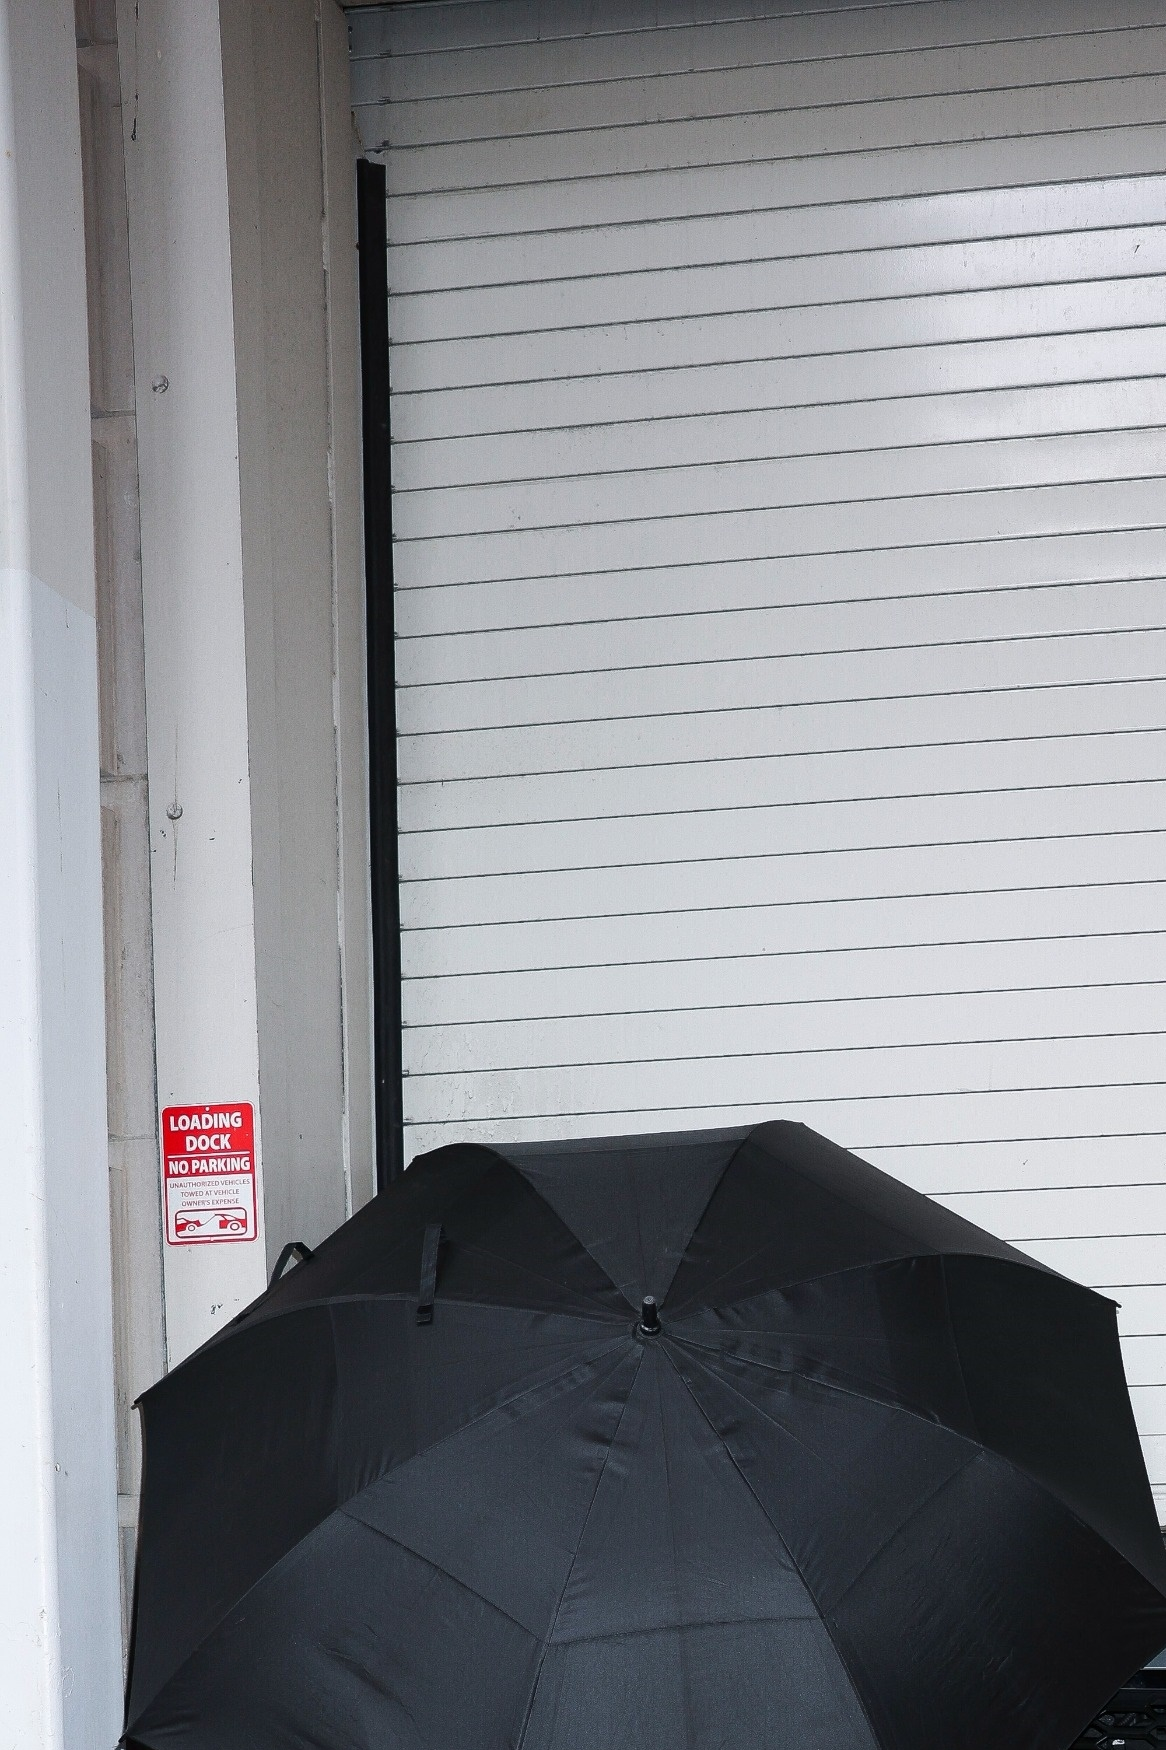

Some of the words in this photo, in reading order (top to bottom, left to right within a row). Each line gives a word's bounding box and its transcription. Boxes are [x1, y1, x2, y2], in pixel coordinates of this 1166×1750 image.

[169, 1111, 242, 1131] LOADING
[185, 1133, 232, 1152] DOCK
[168, 1160, 189, 1175] NO
[191, 1156, 251, 1174] PARKING
[169, 1180, 220, 1189] UNAUTHORIZED
[220, 1178, 251, 1186] VEHICLES
[180, 1190, 204, 1198] TOWED
[213, 1188, 240, 1196] VEHICLE
[181, 1199, 211, 1207] OWNER'S
[211, 1197, 240, 1206] EXPENSE
